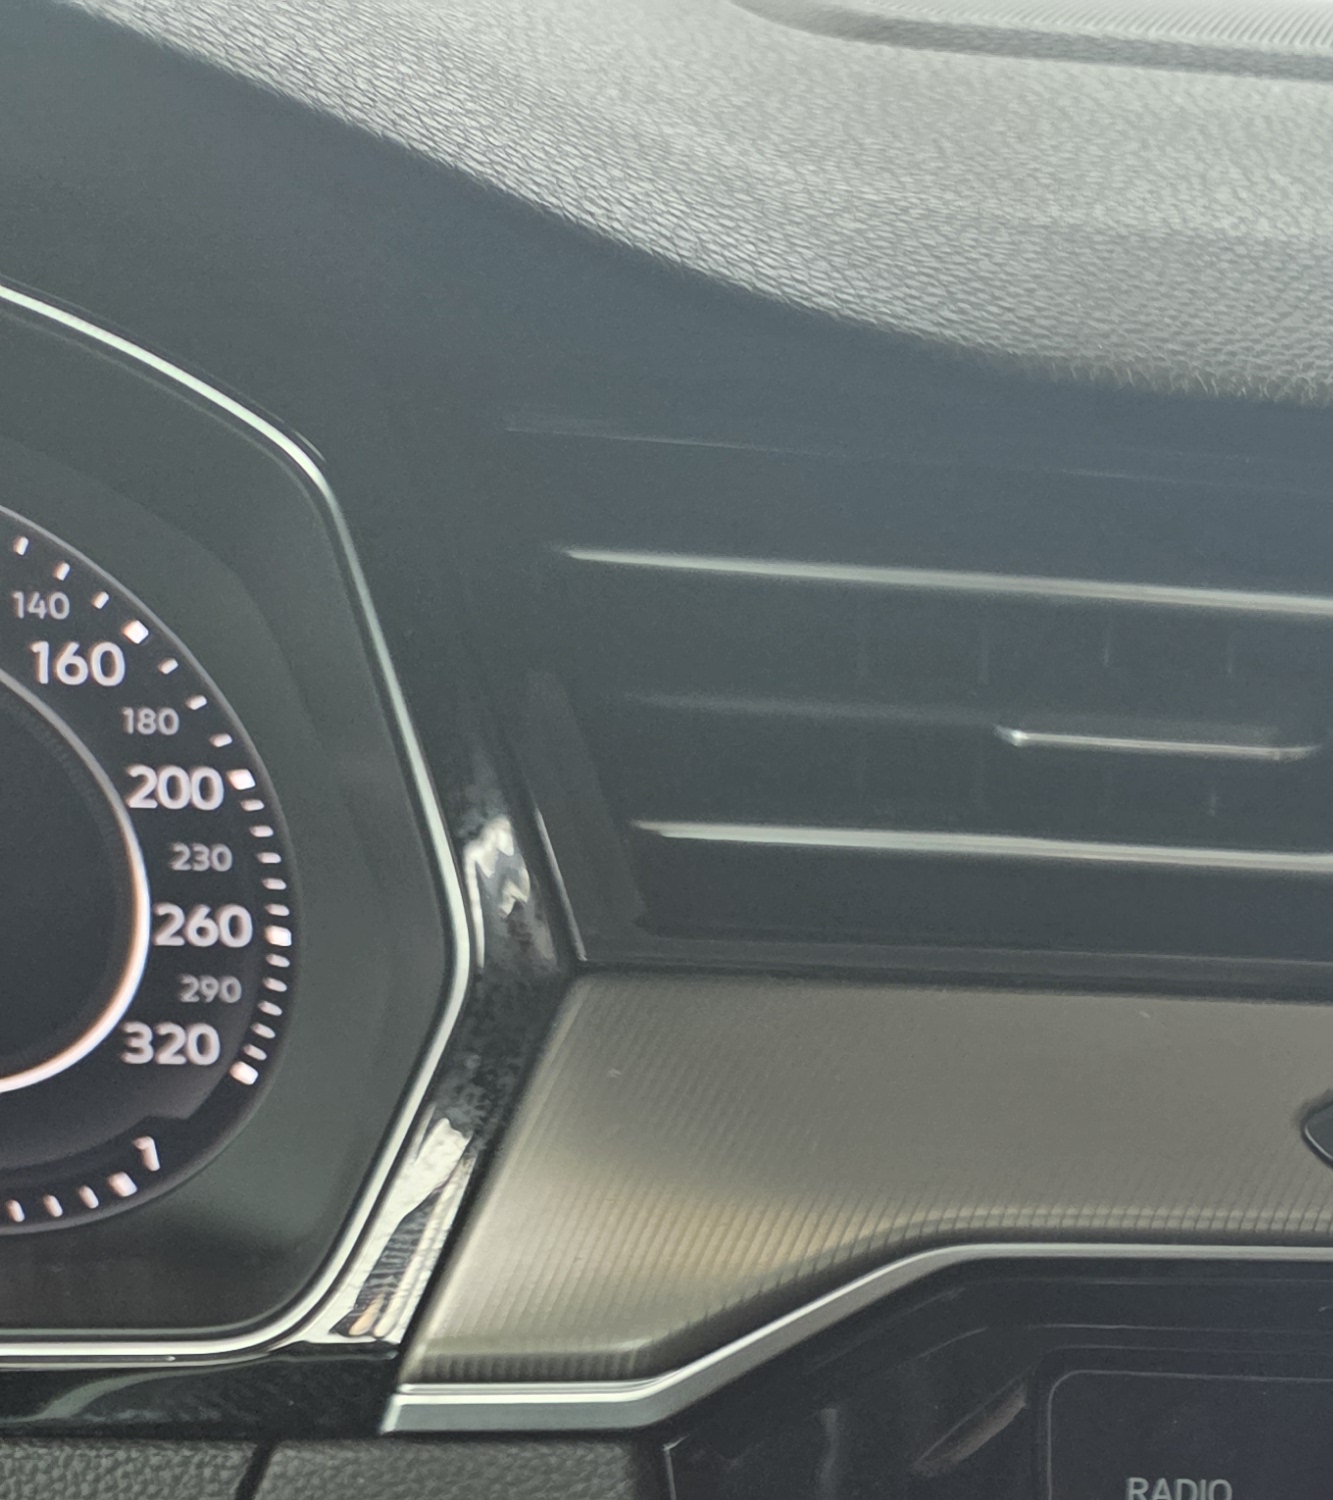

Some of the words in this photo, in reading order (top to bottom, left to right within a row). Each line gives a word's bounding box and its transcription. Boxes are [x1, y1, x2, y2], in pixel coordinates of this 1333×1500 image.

[13, 591, 70, 620] 140
[31, 641, 126, 687] 160
[123, 707, 180, 736] 180
[126, 765, 225, 810] 200
[170, 843, 233, 872] 230
[153, 903, 253, 948] 260
[179, 975, 242, 1004] 290
[122, 1022, 221, 1066] 320
